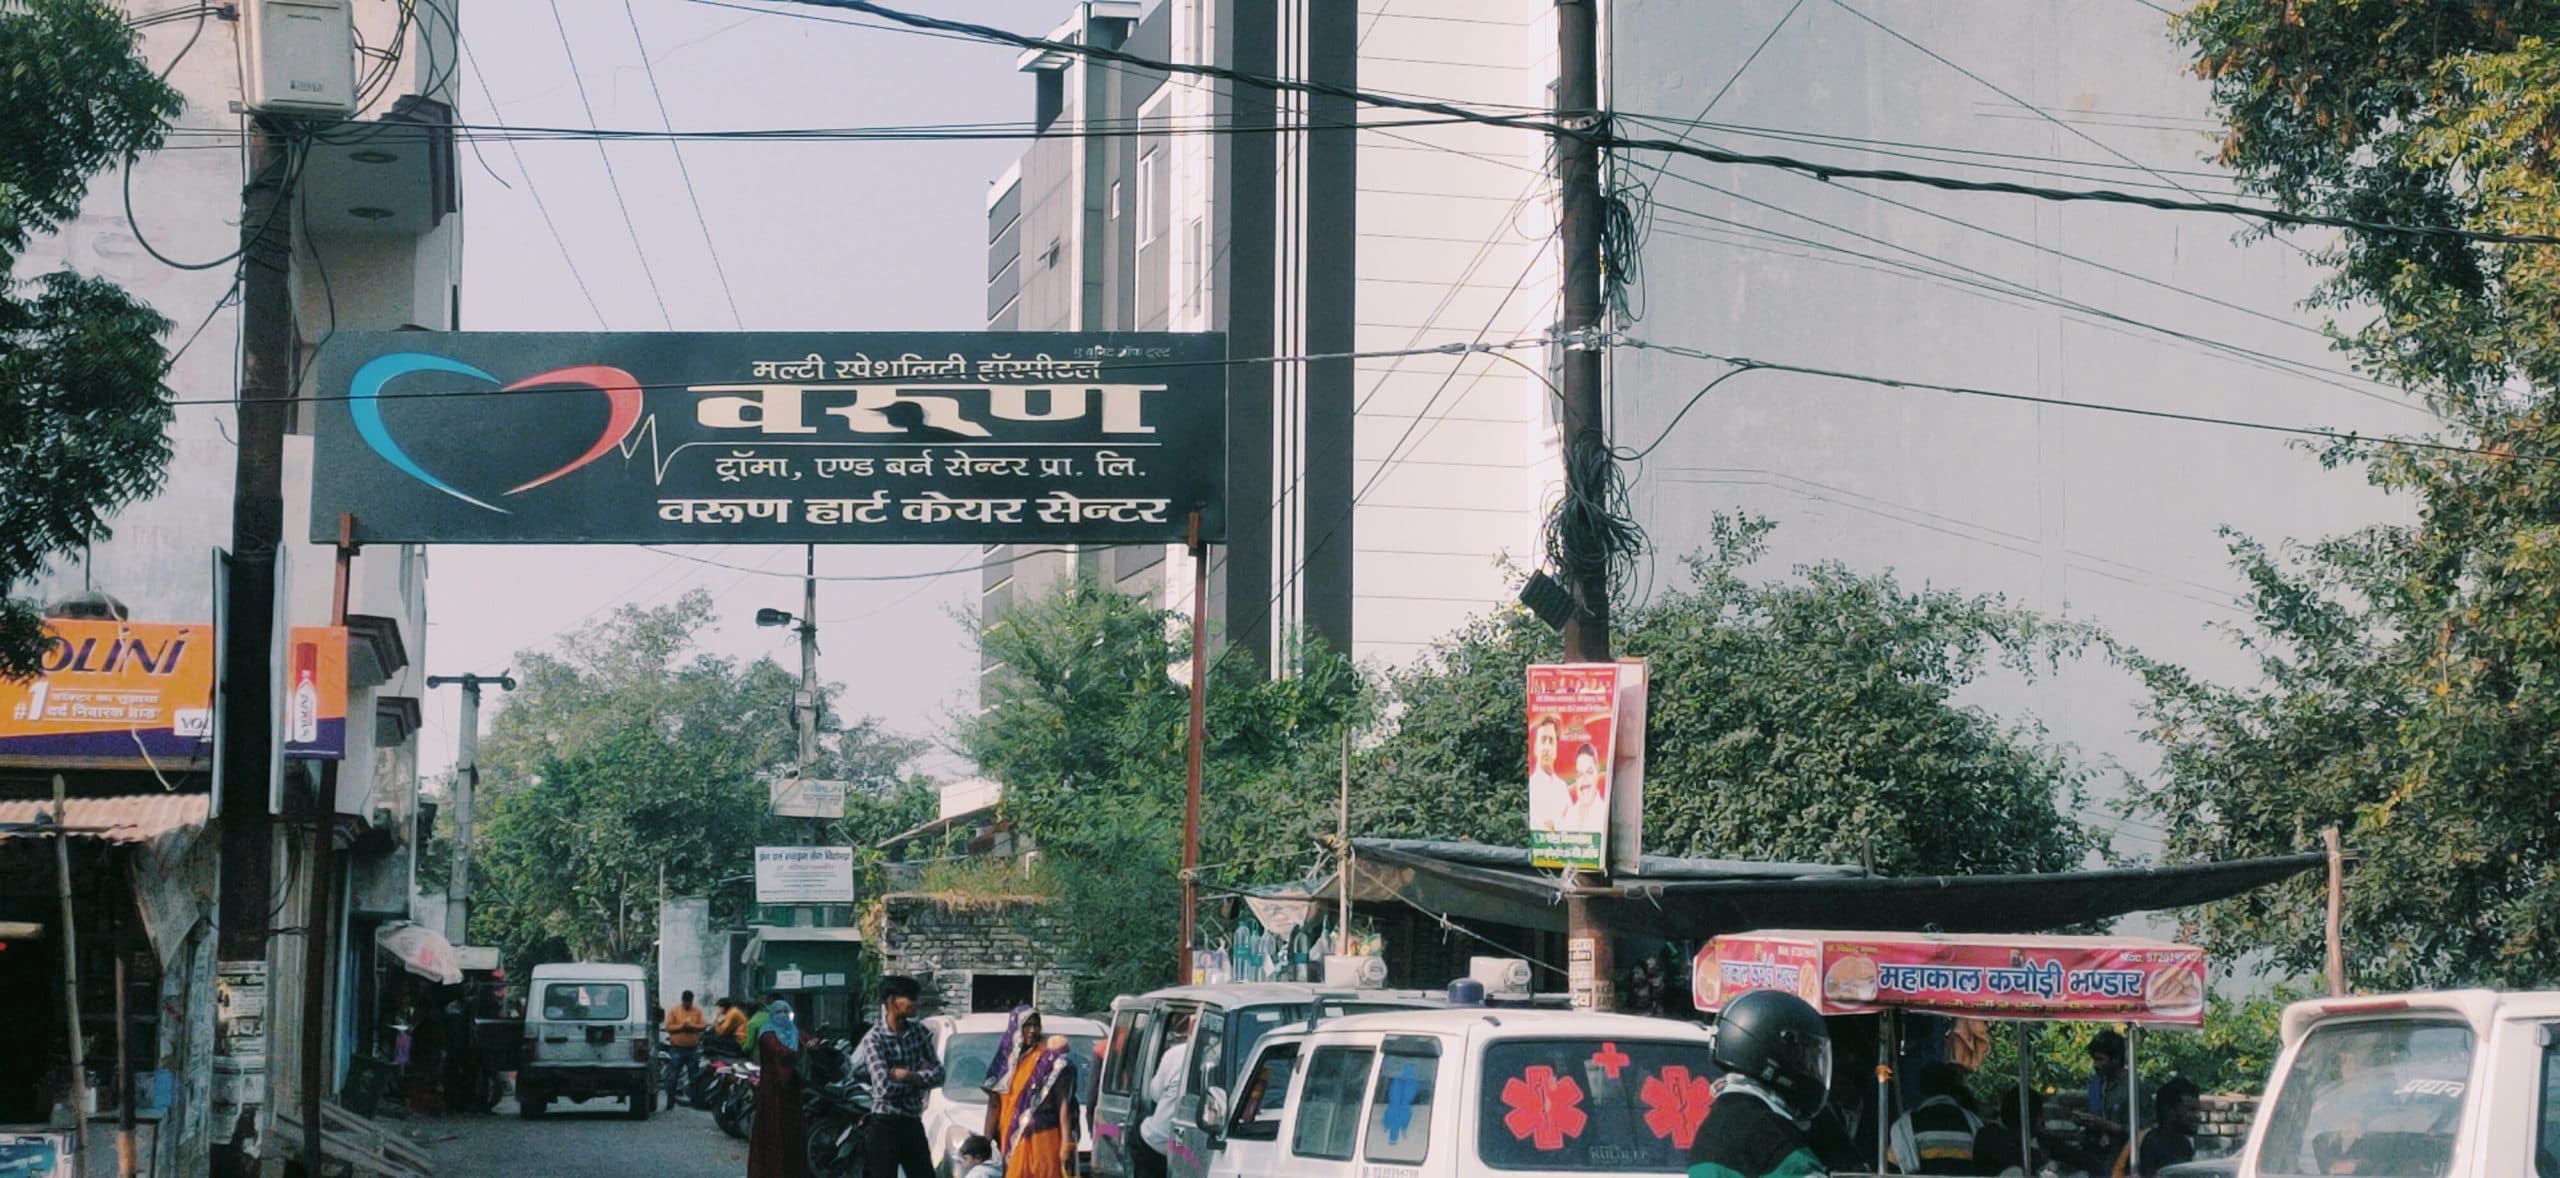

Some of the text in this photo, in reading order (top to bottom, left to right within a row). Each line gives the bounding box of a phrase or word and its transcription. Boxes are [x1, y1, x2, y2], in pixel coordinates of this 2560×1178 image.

[751, 352, 1103, 383] मल्टी स्पेशलिटी हॉस्पीटल
[814, 457, 874, 479] एण्ड
[883, 449, 934, 477] बर्न
[944, 449, 1030, 477] सेन्टर
[1039, 457, 1083, 479] प्रा.
[1096, 450, 1147, 477] लि.
[657, 490, 1172, 525] वरूण हार्ट केयर सेन्टर
[40, 628, 189, 674] OLINI
[1878, 958, 2145, 1001] महाकाल कचौड़ी भण्डार
